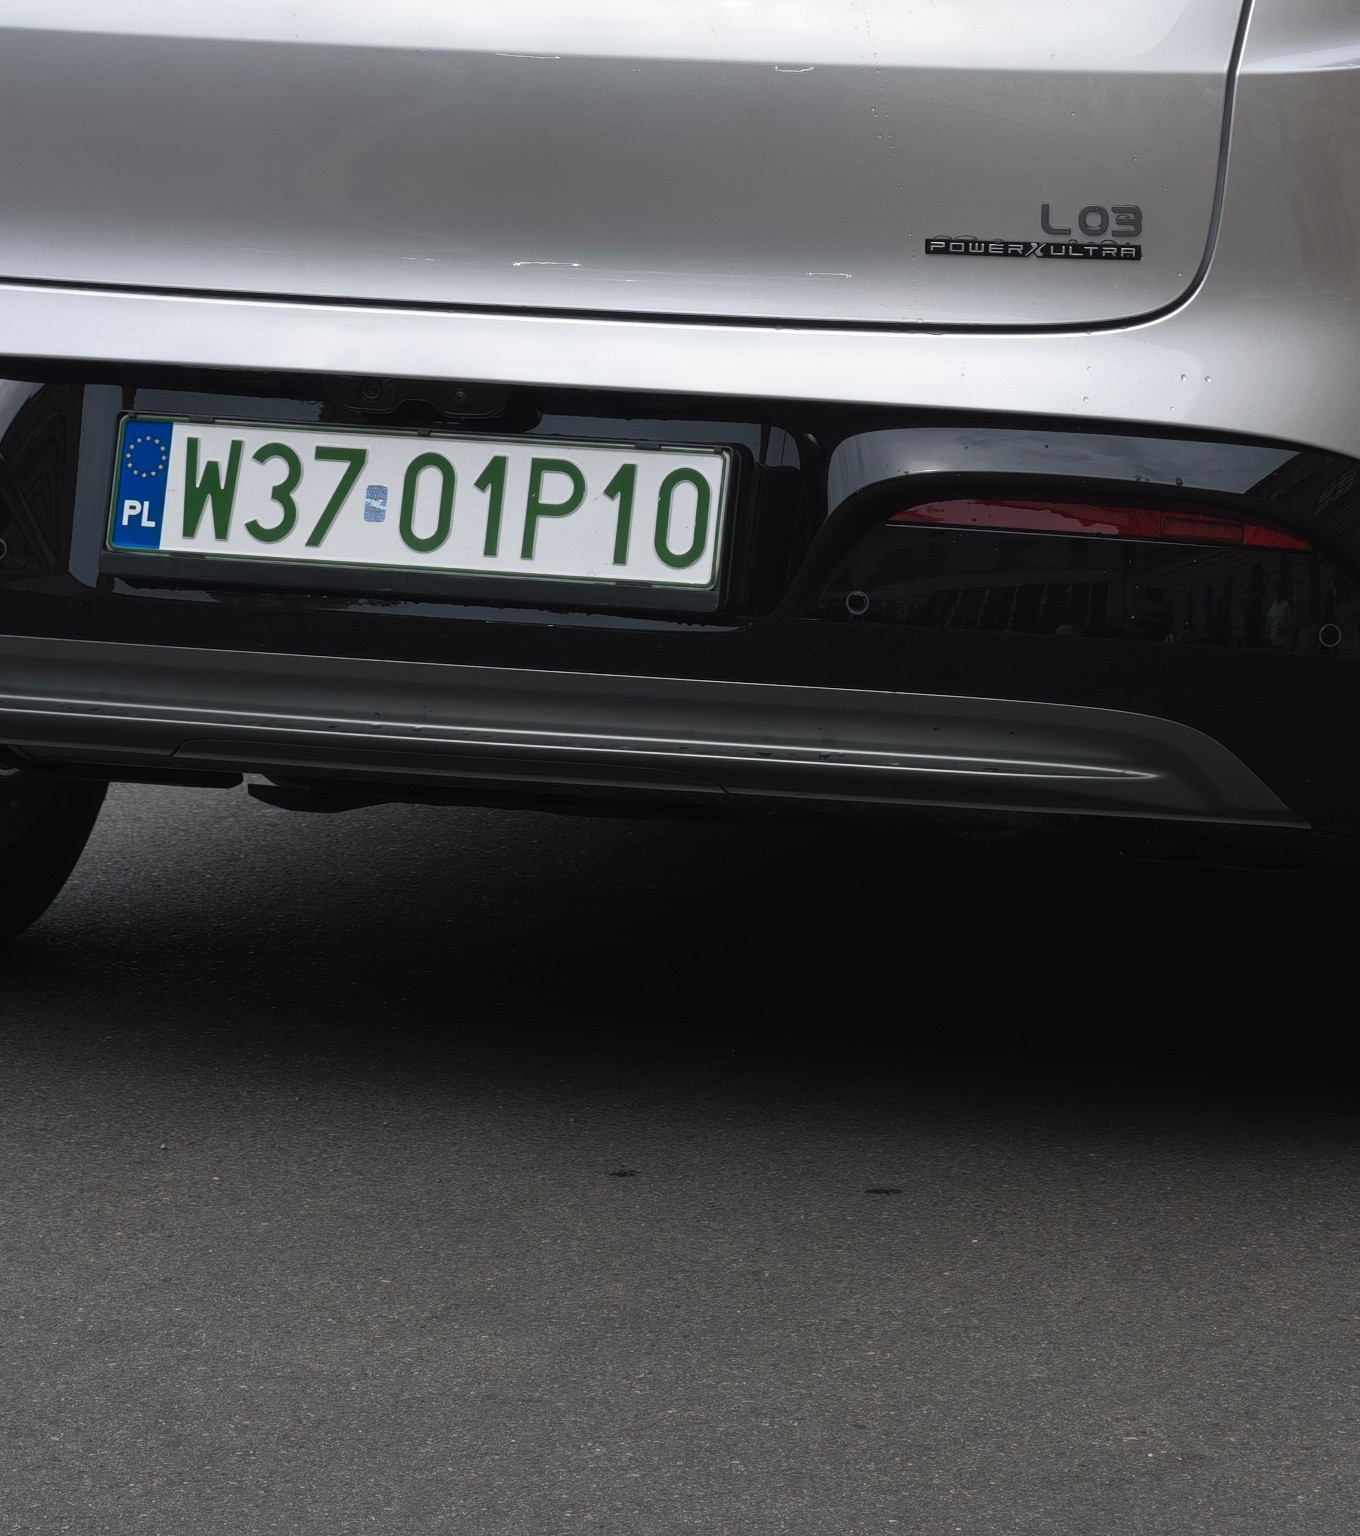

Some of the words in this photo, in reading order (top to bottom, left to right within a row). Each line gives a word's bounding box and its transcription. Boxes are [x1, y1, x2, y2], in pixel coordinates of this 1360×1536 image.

[1040, 202, 1143, 238] L03
[120, 498, 156, 528] PL
[181, 435, 370, 549] W37
[397, 451, 712, 569] 01P10
